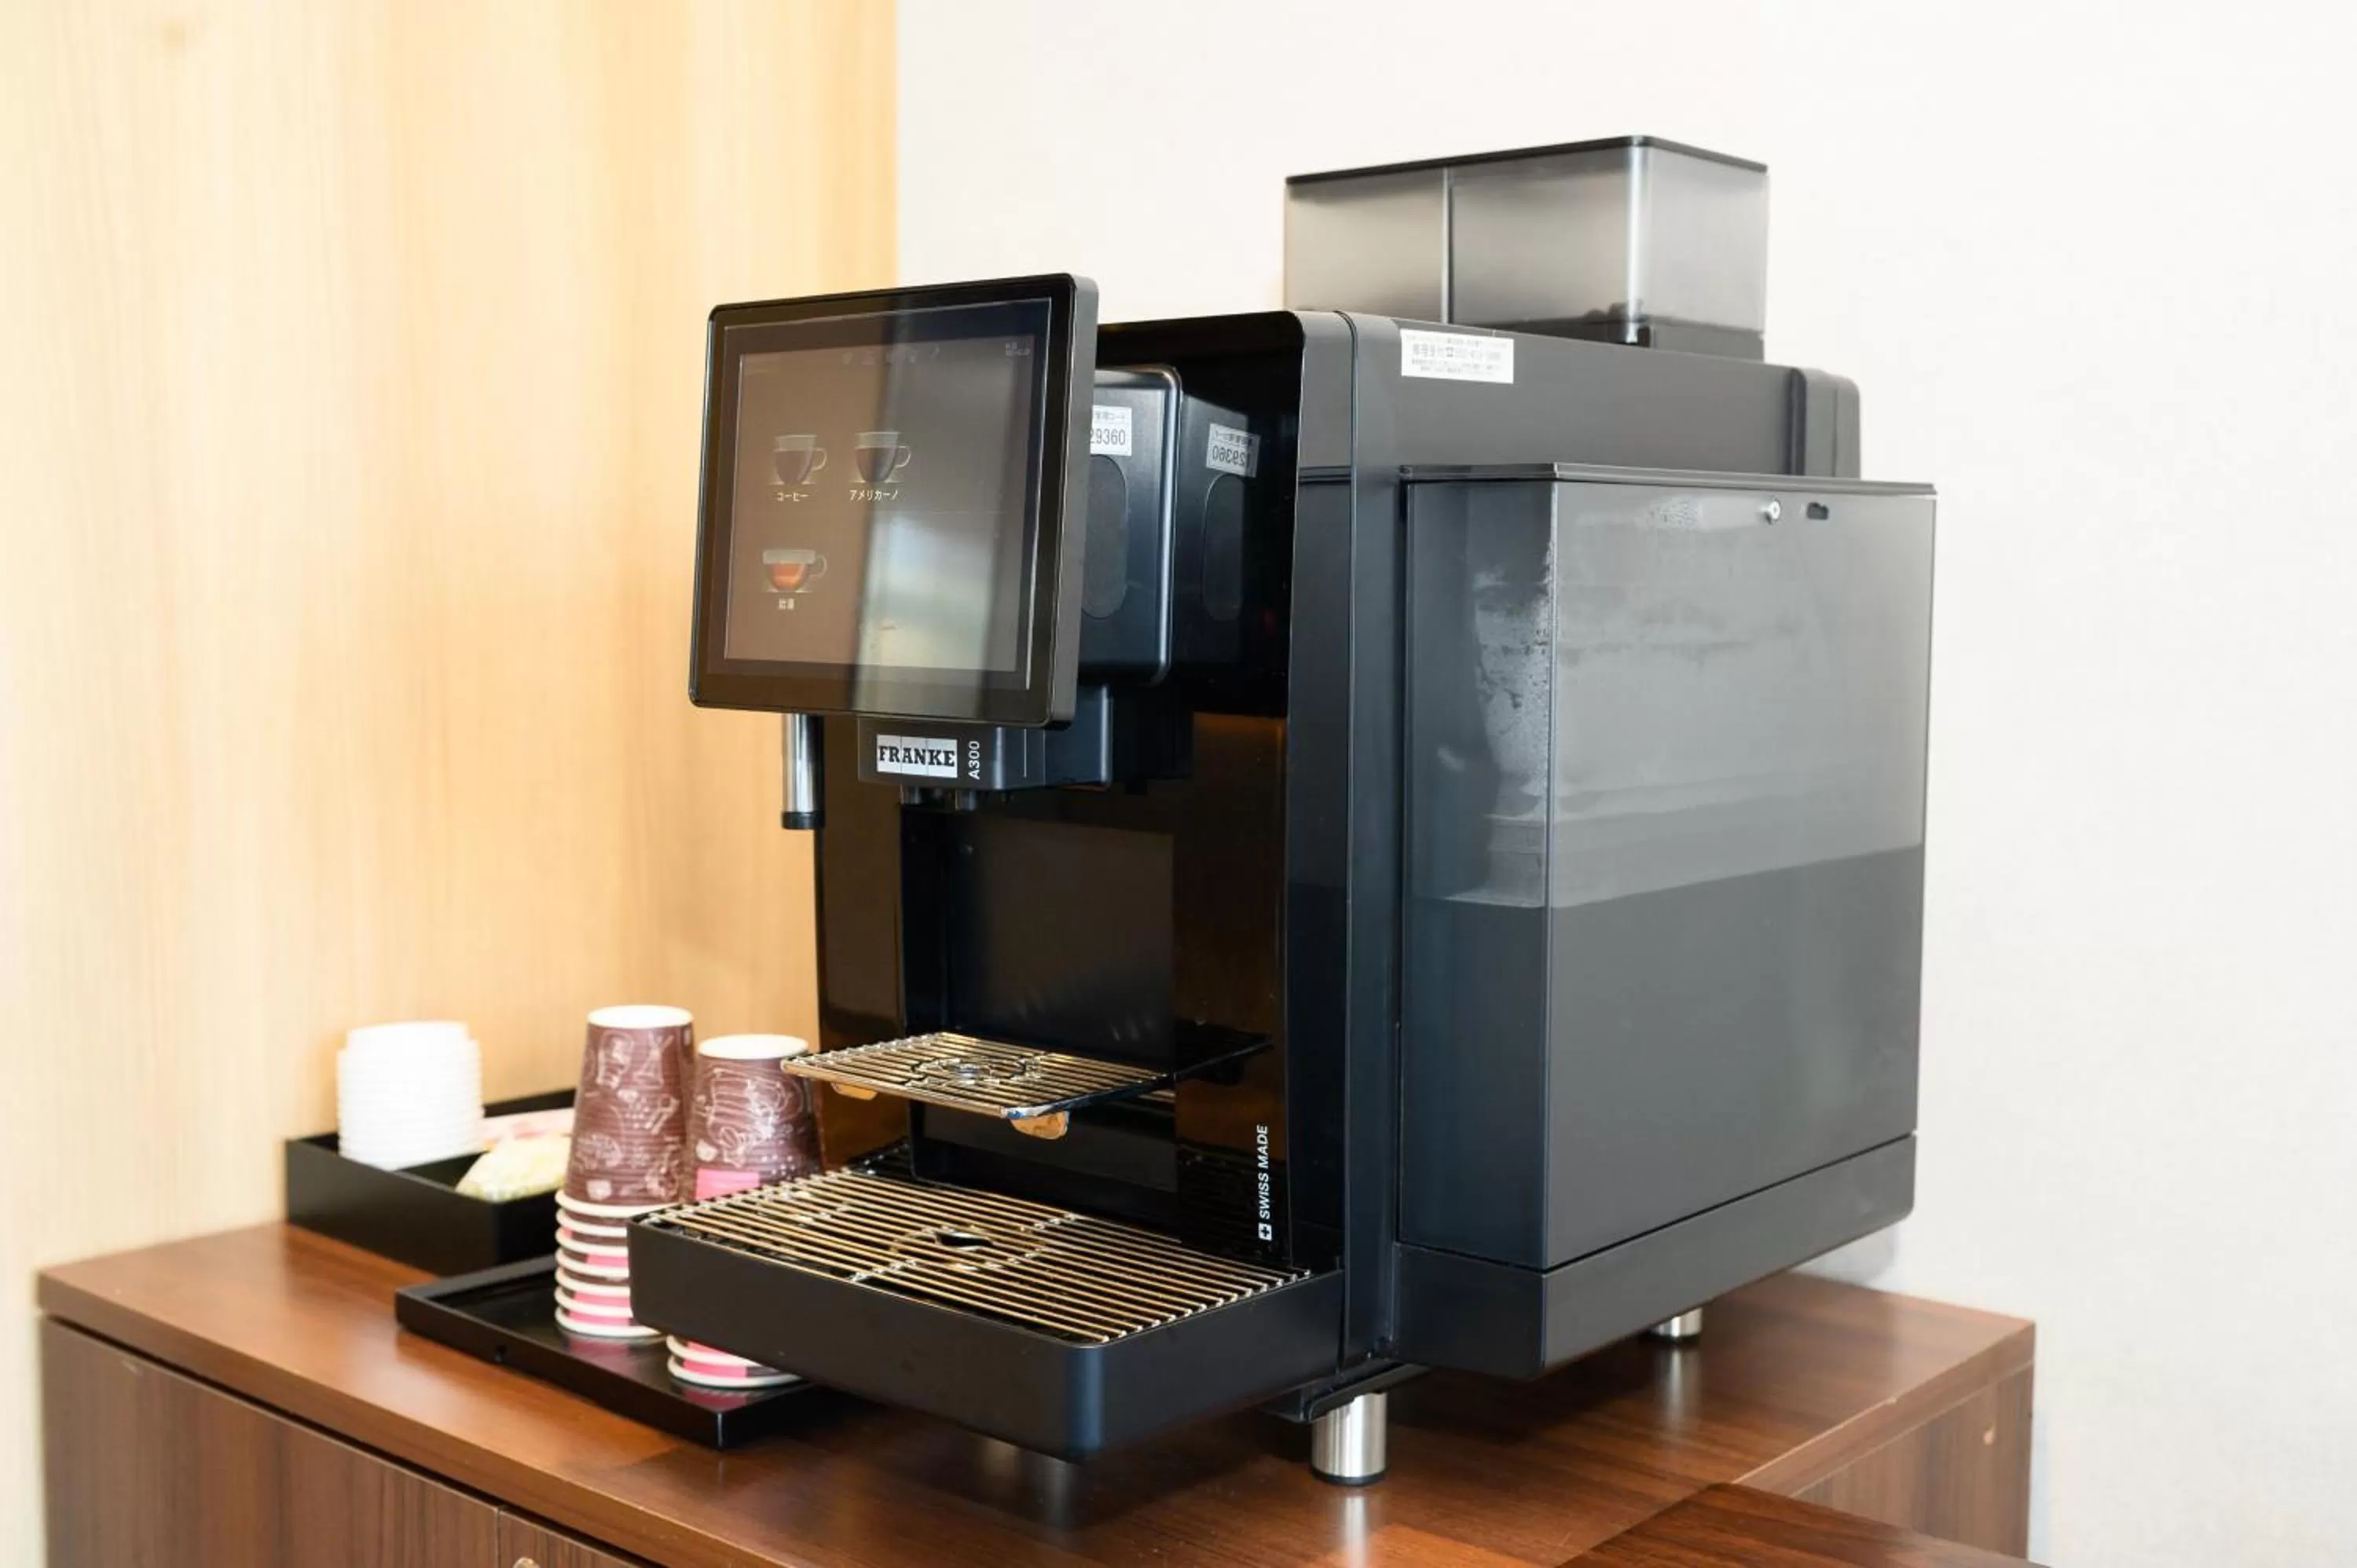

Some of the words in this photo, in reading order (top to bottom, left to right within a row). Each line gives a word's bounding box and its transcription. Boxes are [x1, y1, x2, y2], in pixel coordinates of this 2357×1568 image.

[775, 491, 810, 502] コーヒー
[849, 489, 899, 502] アメリカーノ
[878, 746, 955, 768] FRANKE
[967, 740, 981, 780] A300
[1255, 1124, 1269, 1170] MADE
[1257, 1171, 1270, 1220] SWISS
